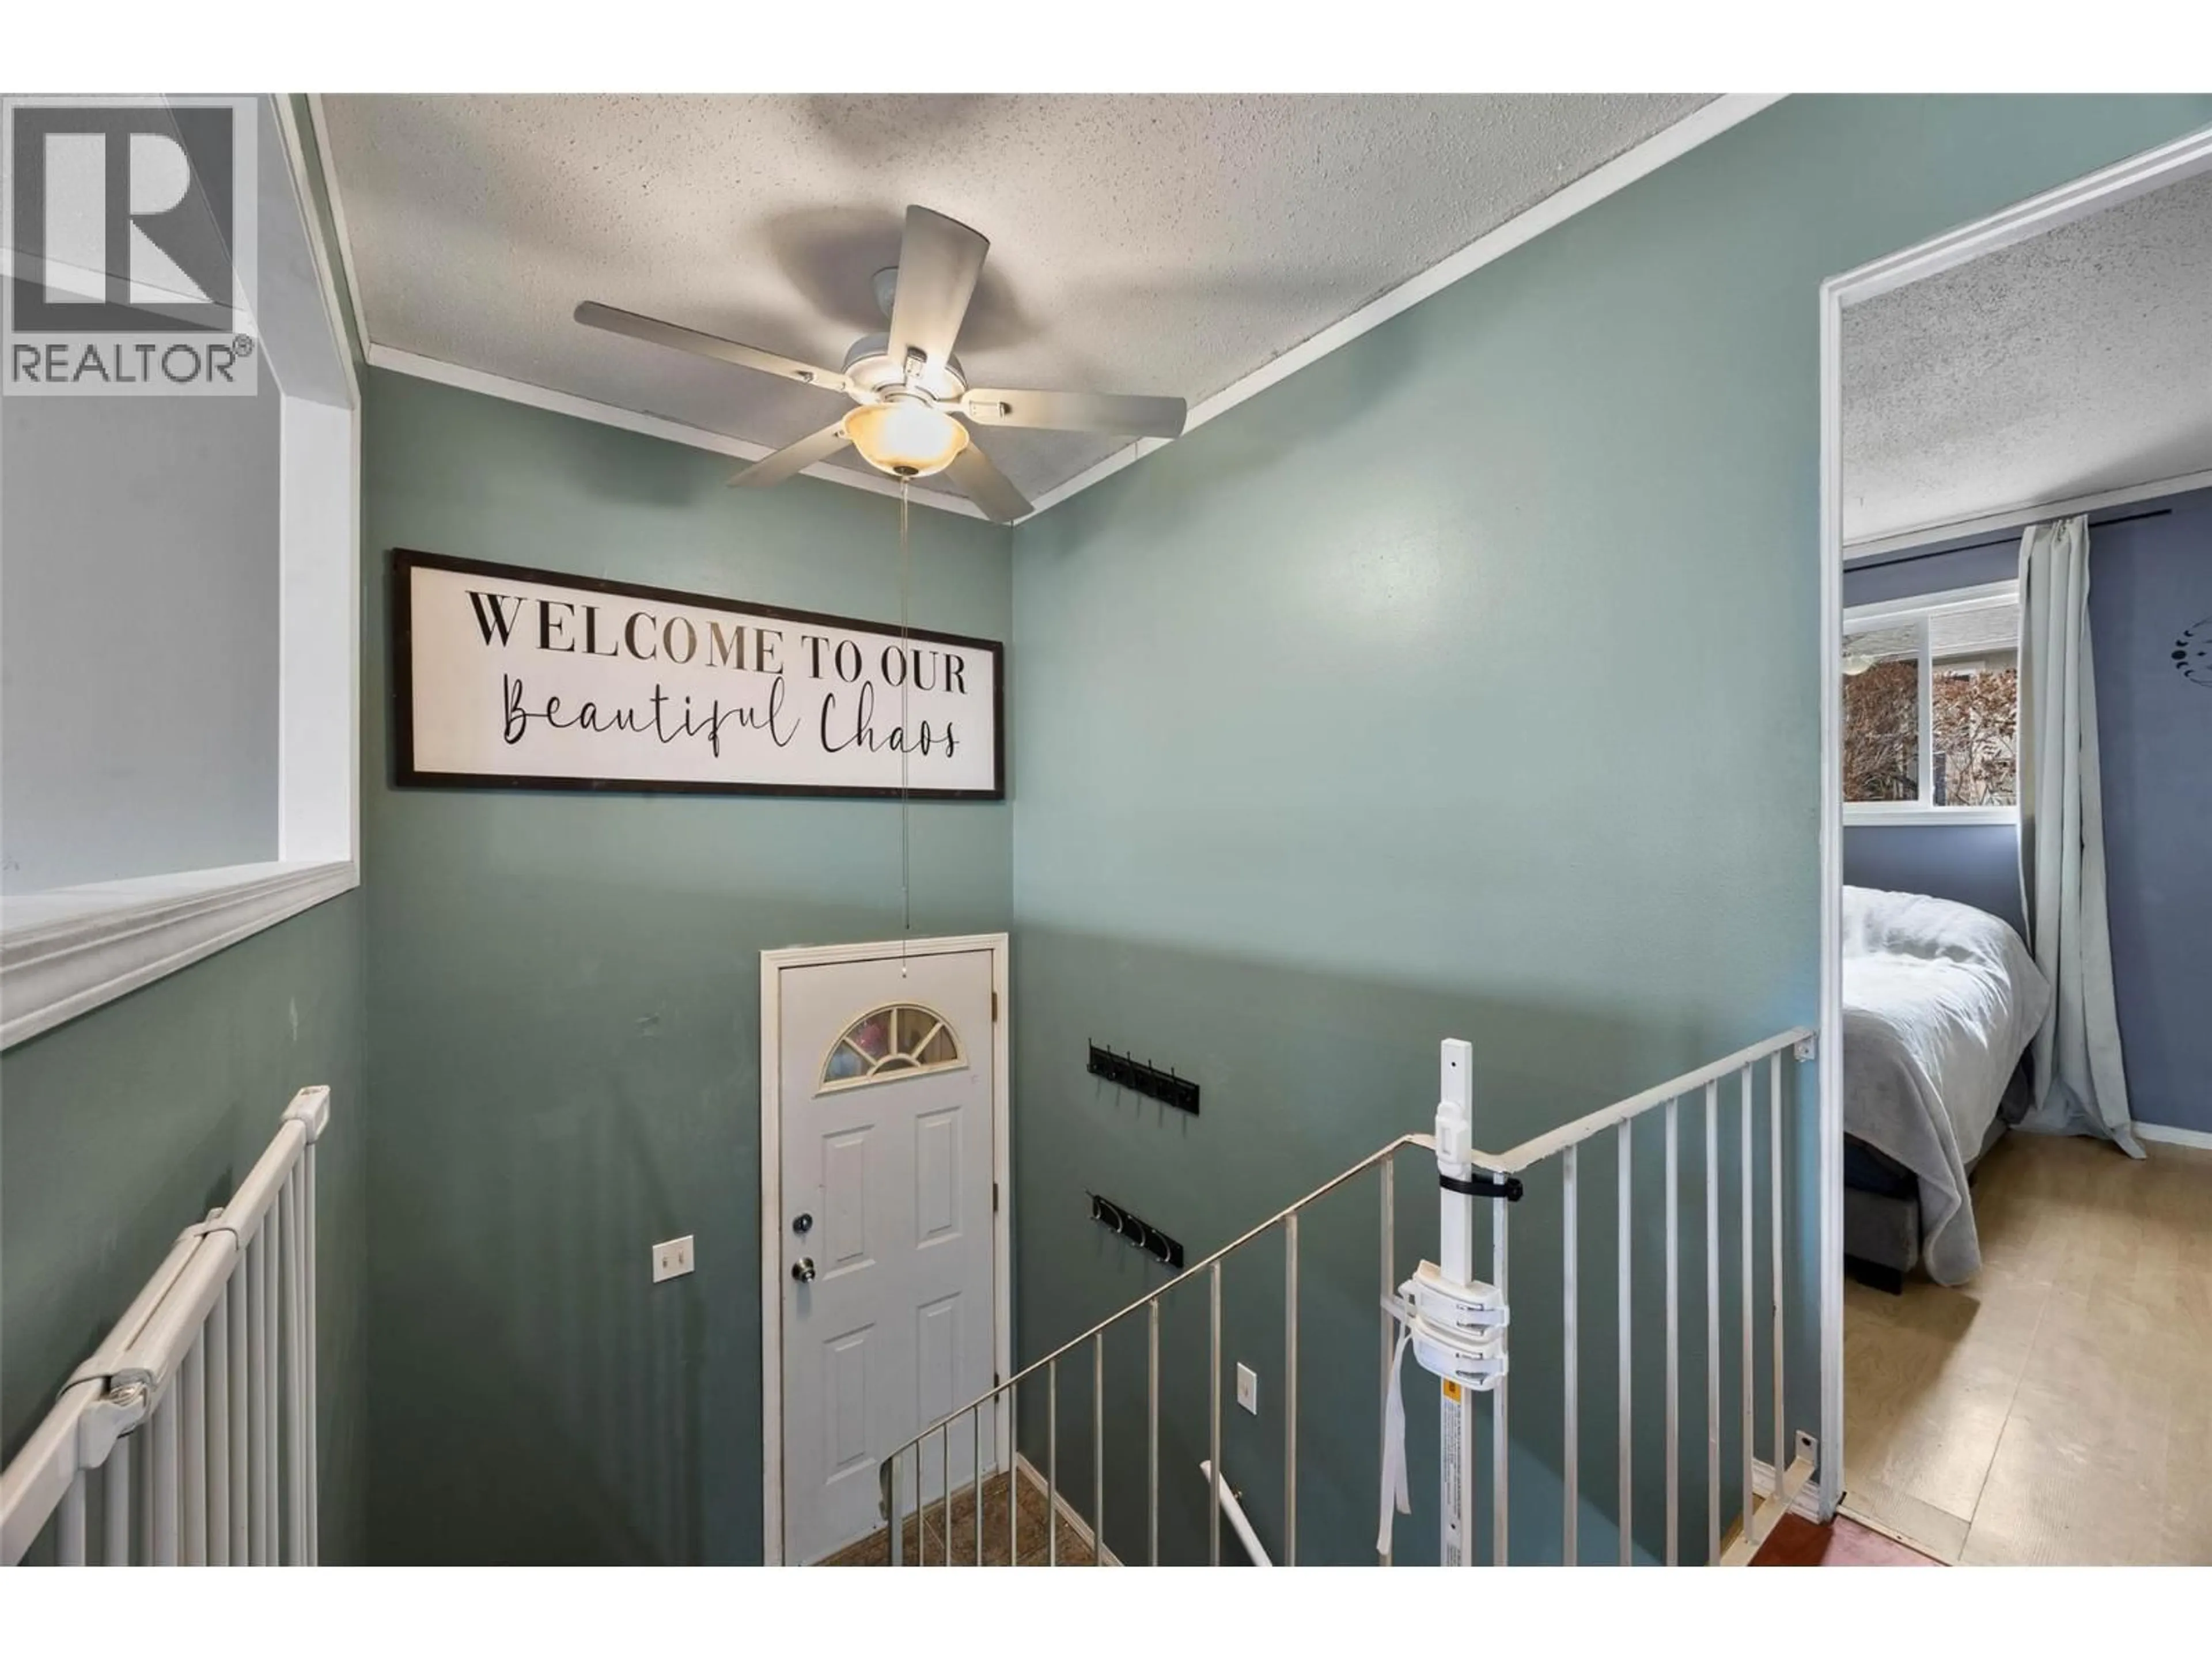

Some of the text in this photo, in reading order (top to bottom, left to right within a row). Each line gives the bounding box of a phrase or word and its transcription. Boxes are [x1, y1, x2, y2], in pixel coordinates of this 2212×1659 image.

[465, 590, 968, 695] WELCOME TO OUR
[502, 673, 960, 759] Beautiful Chaos
